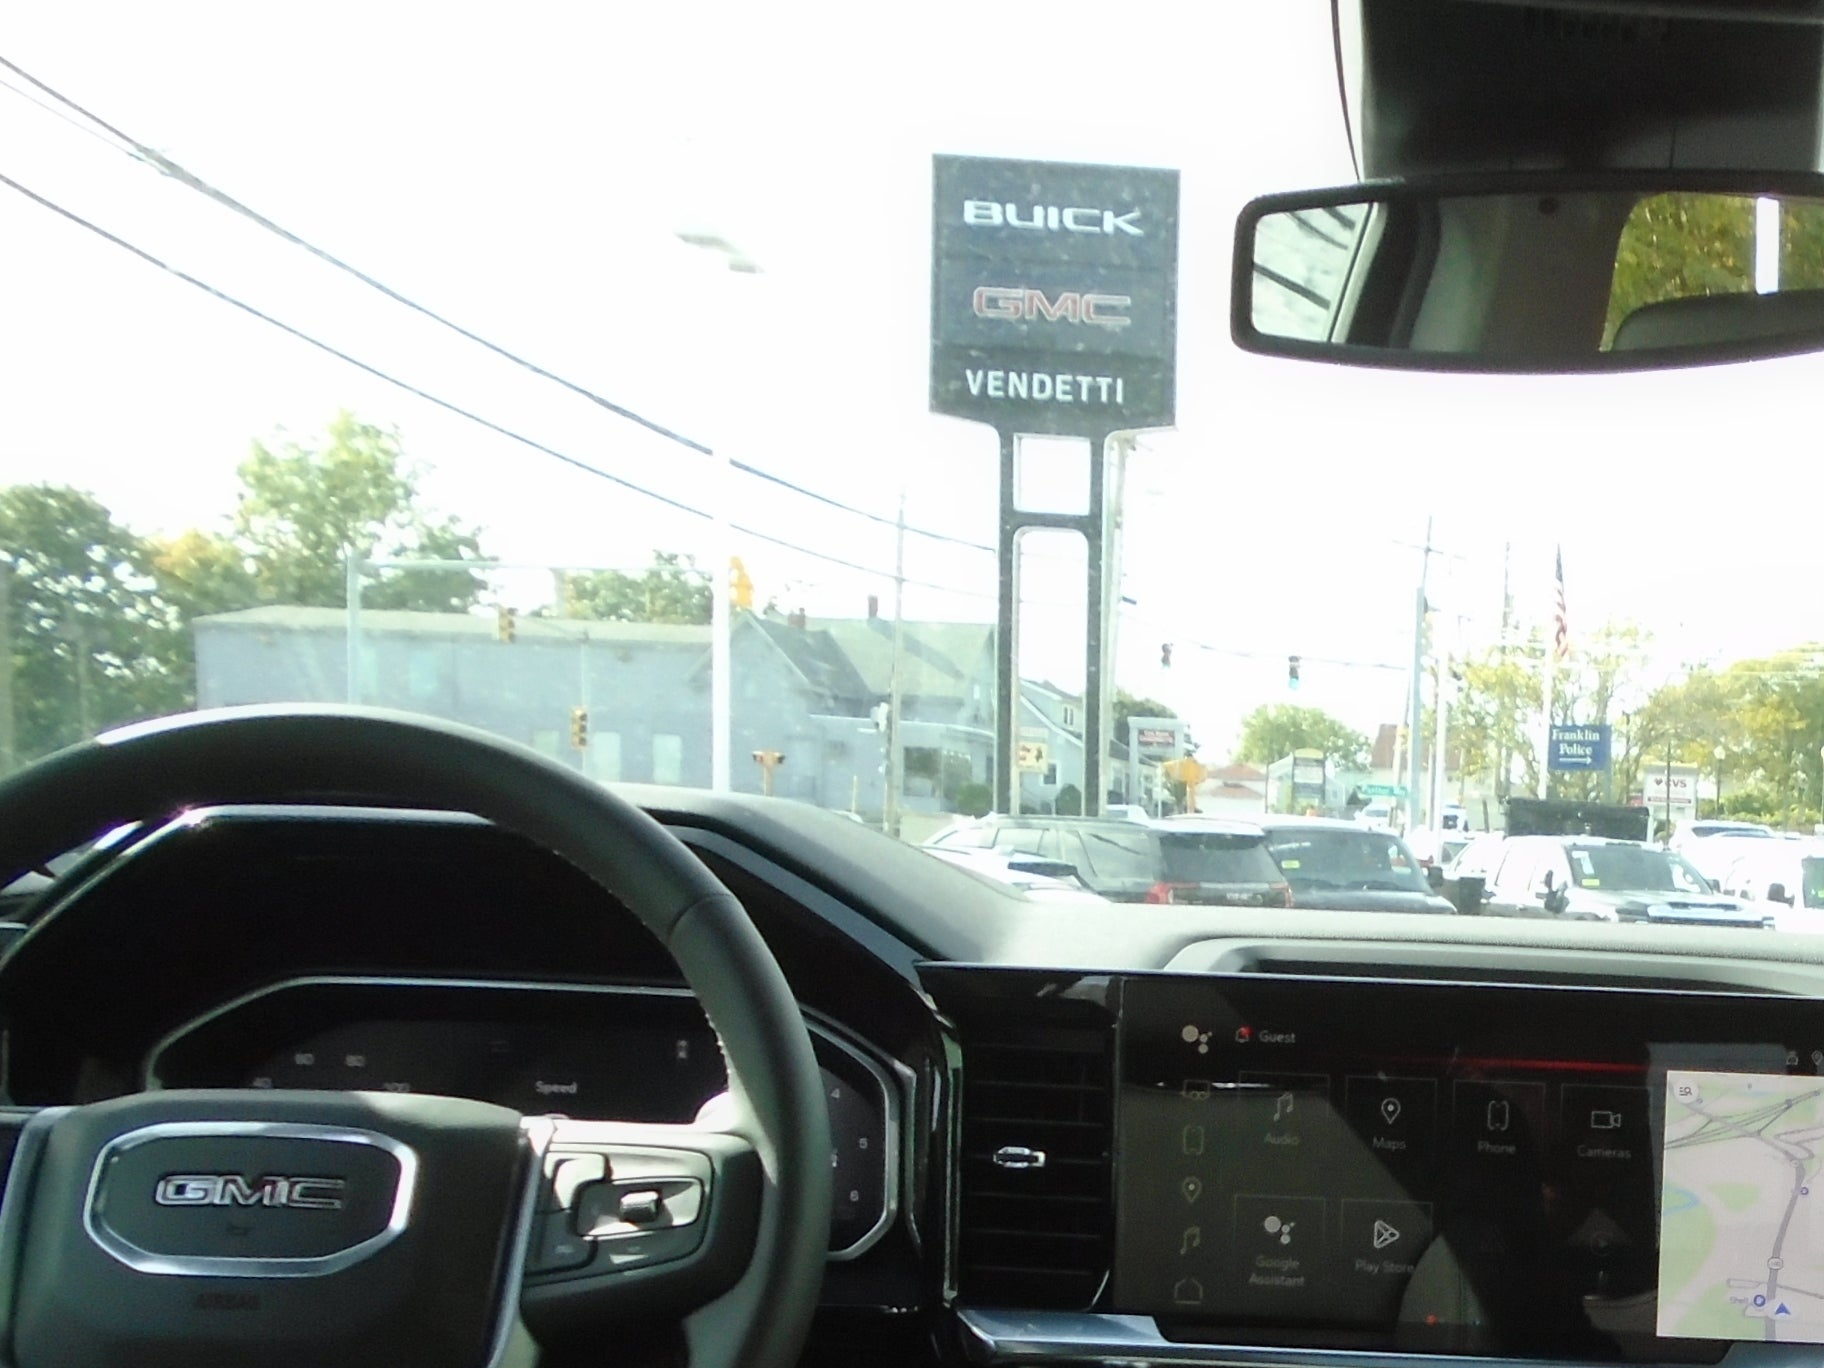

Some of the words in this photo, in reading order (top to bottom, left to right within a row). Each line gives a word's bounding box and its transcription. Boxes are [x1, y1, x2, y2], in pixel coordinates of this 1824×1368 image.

[963, 199, 1144, 236] BUICK
[973, 285, 1132, 326] GMC
[965, 368, 1125, 404] VENDETTI
[1552, 729, 1600, 741] Franklin
[1559, 743, 1593, 755] Police
[1258, 1029, 1296, 1044] Guest
[535, 1080, 578, 1096] Speed
[830, 1087, 841, 1099] 4
[858, 1137, 868, 1149] 5
[1263, 1132, 1301, 1146] Audio
[1372, 1136, 1407, 1152] Maps
[1477, 1140, 1517, 1155] Phone
[1576, 1144, 1632, 1160] Cameras
[156, 1174, 346, 1210] GMC
[1255, 1254, 1301, 1271] Google
[1355, 1257, 1380, 1275] Play
[1381, 1260, 1415, 1274] Store
[1248, 1272, 1305, 1287] Assistant
